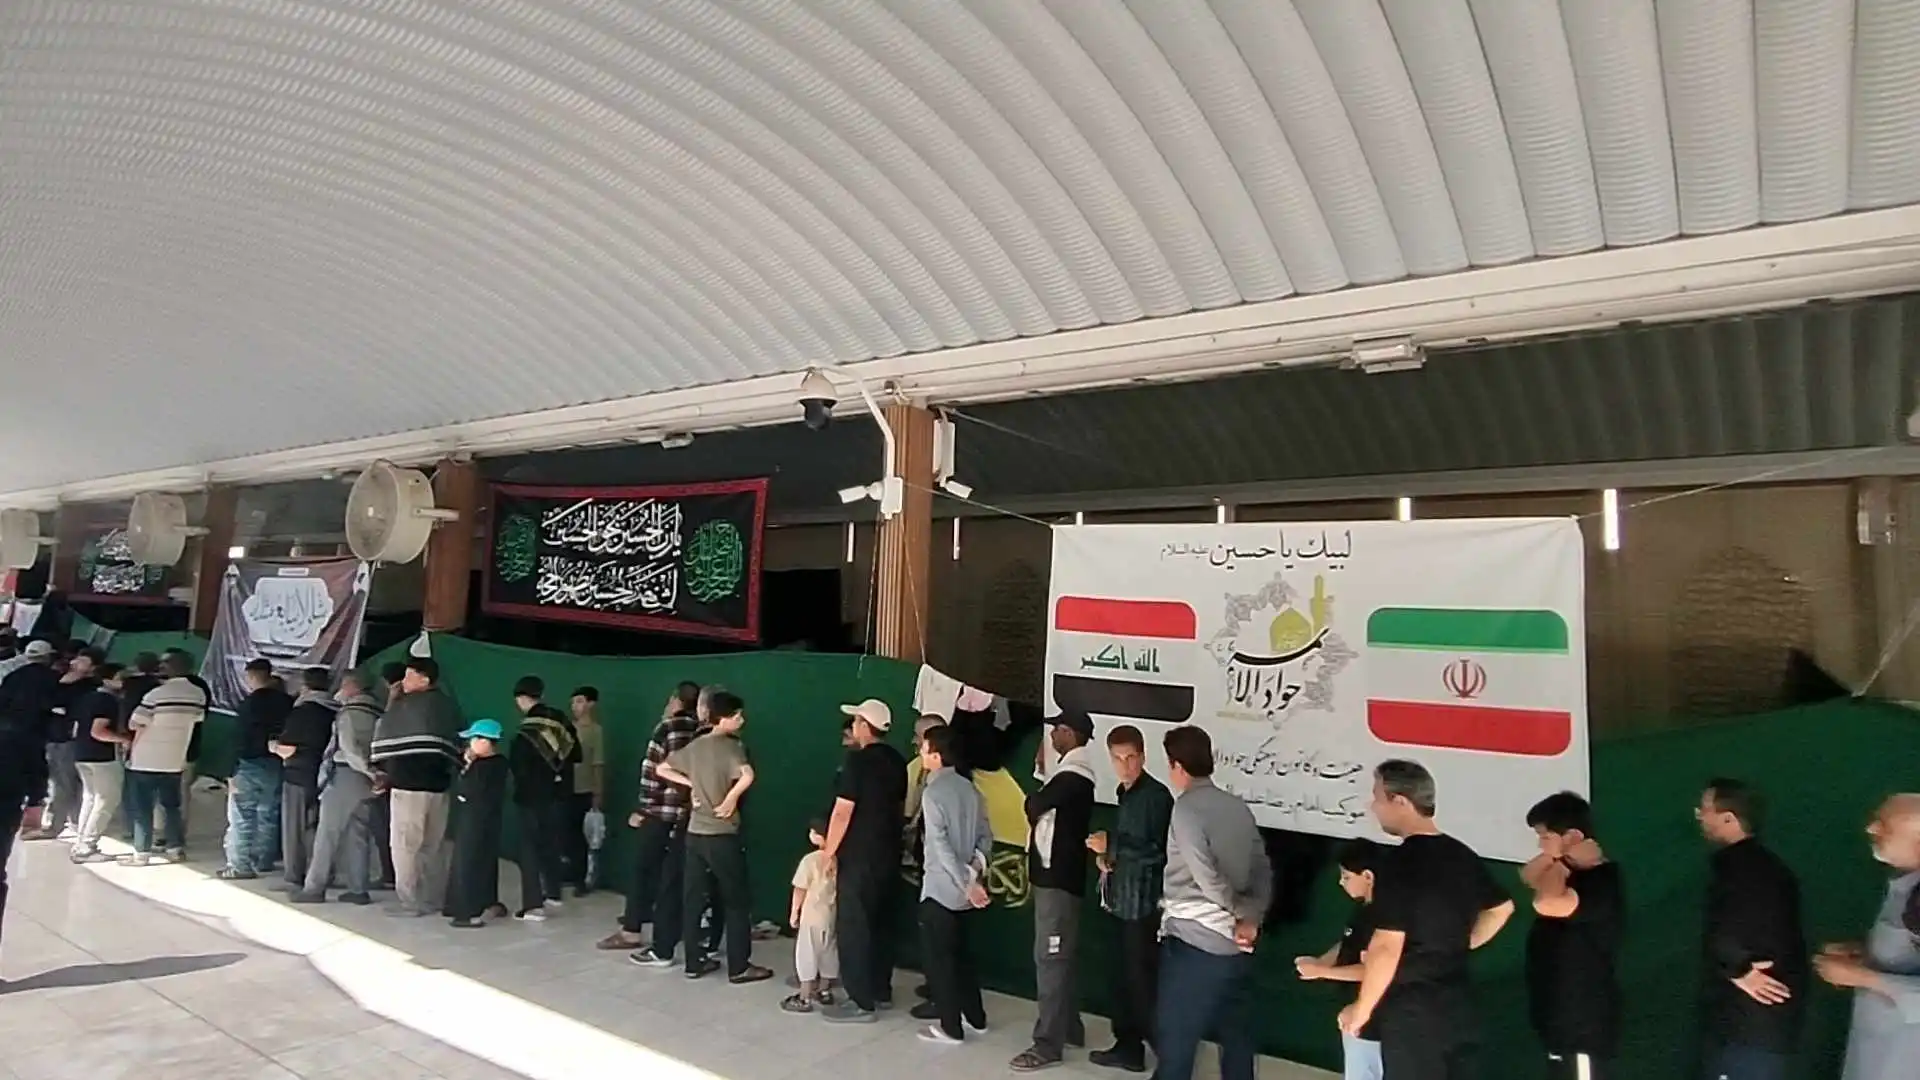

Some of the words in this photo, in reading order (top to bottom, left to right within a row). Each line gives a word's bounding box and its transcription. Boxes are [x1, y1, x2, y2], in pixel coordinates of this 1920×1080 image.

[1209, 543, 1276, 571] حسين
[1279, 528, 1295, 570] يا
[1133, 644, 1160, 673] الله
